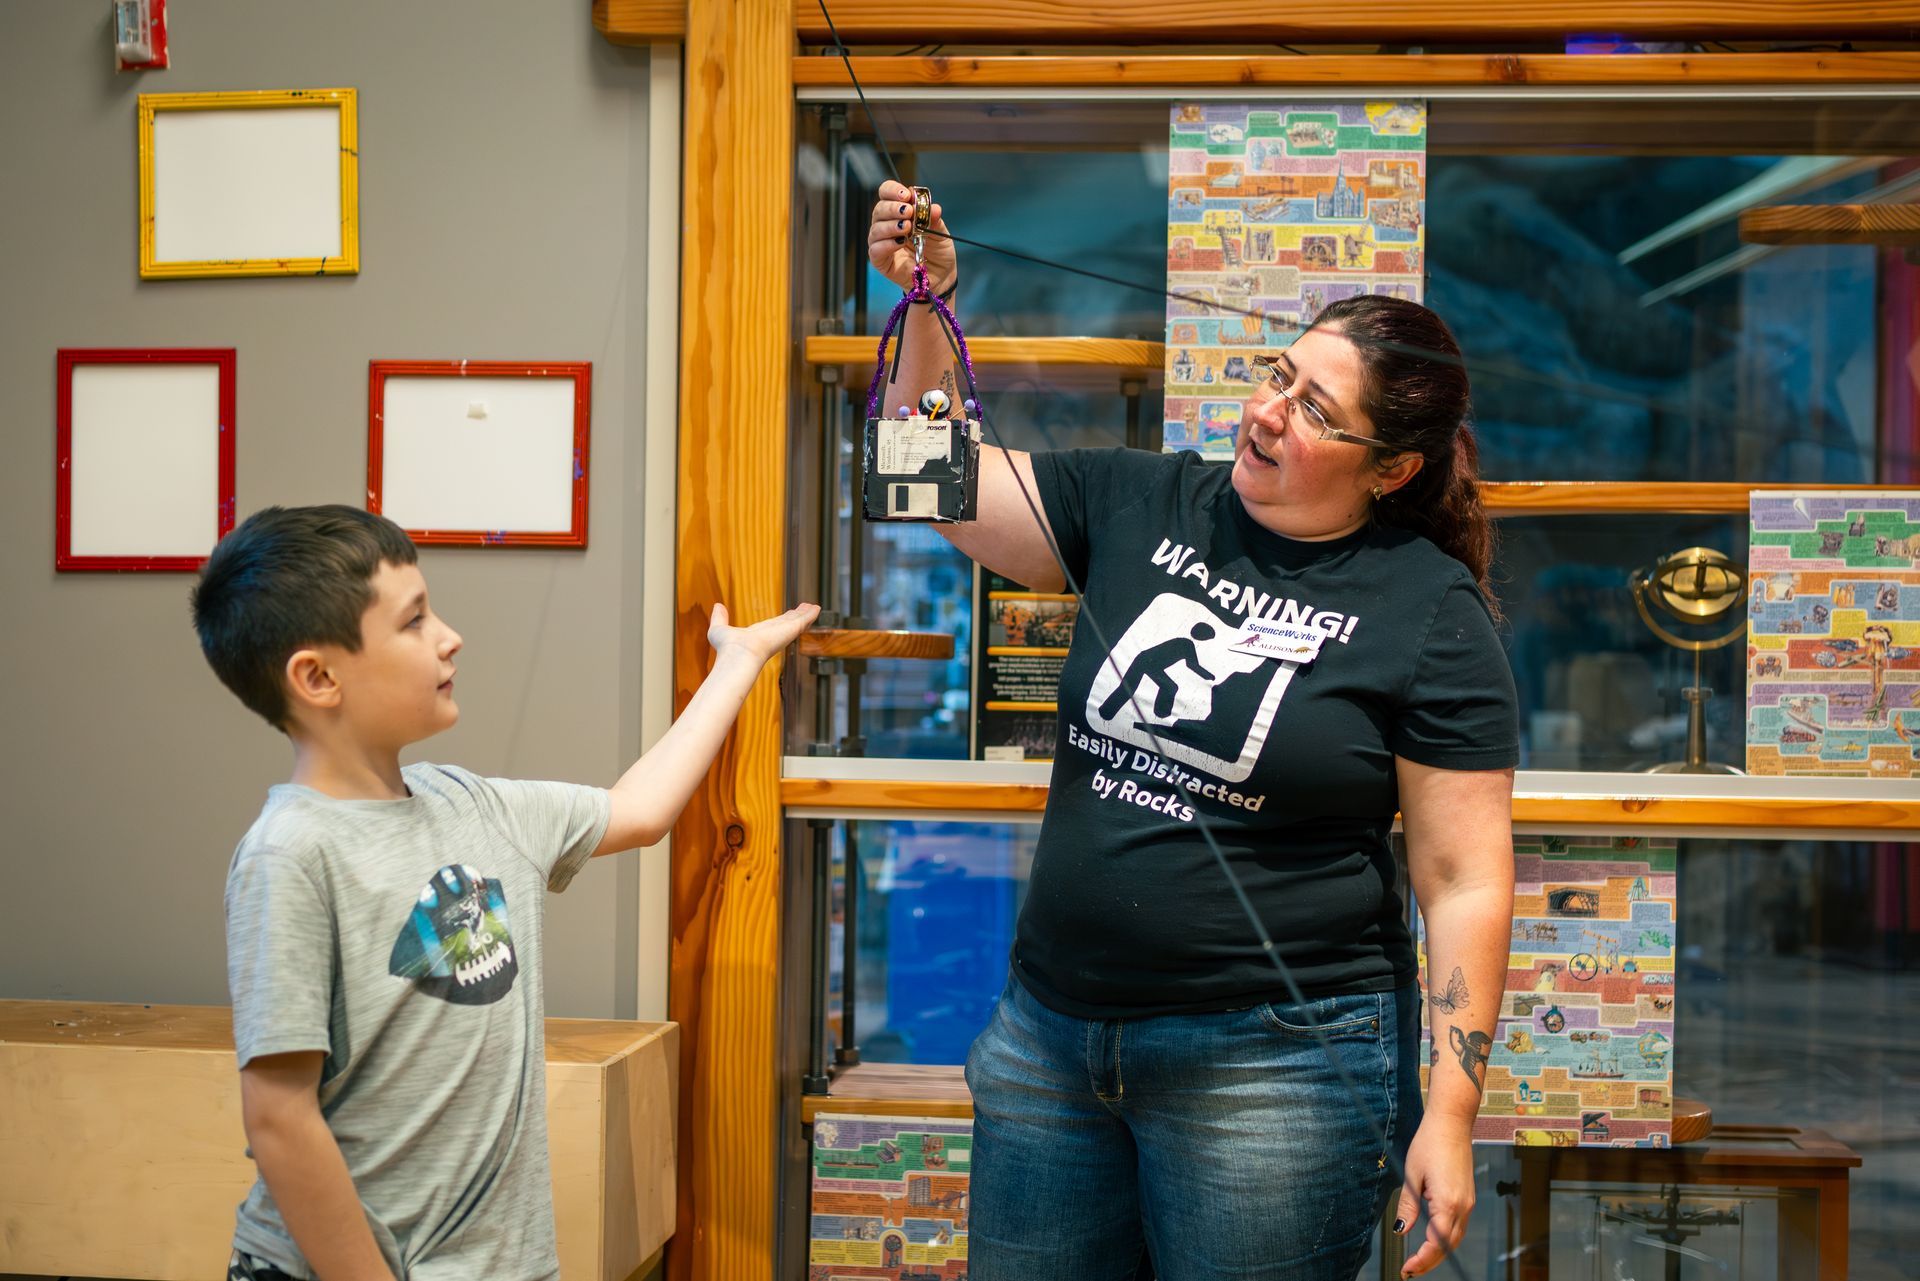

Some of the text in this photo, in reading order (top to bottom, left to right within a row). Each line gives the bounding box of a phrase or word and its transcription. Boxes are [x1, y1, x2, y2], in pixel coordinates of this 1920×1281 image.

[1151, 538, 1359, 644] WARNING!
[1247, 623, 1318, 642] ScienceWorks
[1258, 643, 1295, 654] ALLISON
[1068, 723, 1266, 813] Easily Distracted
[1091, 768, 1197, 822] by Rocks
